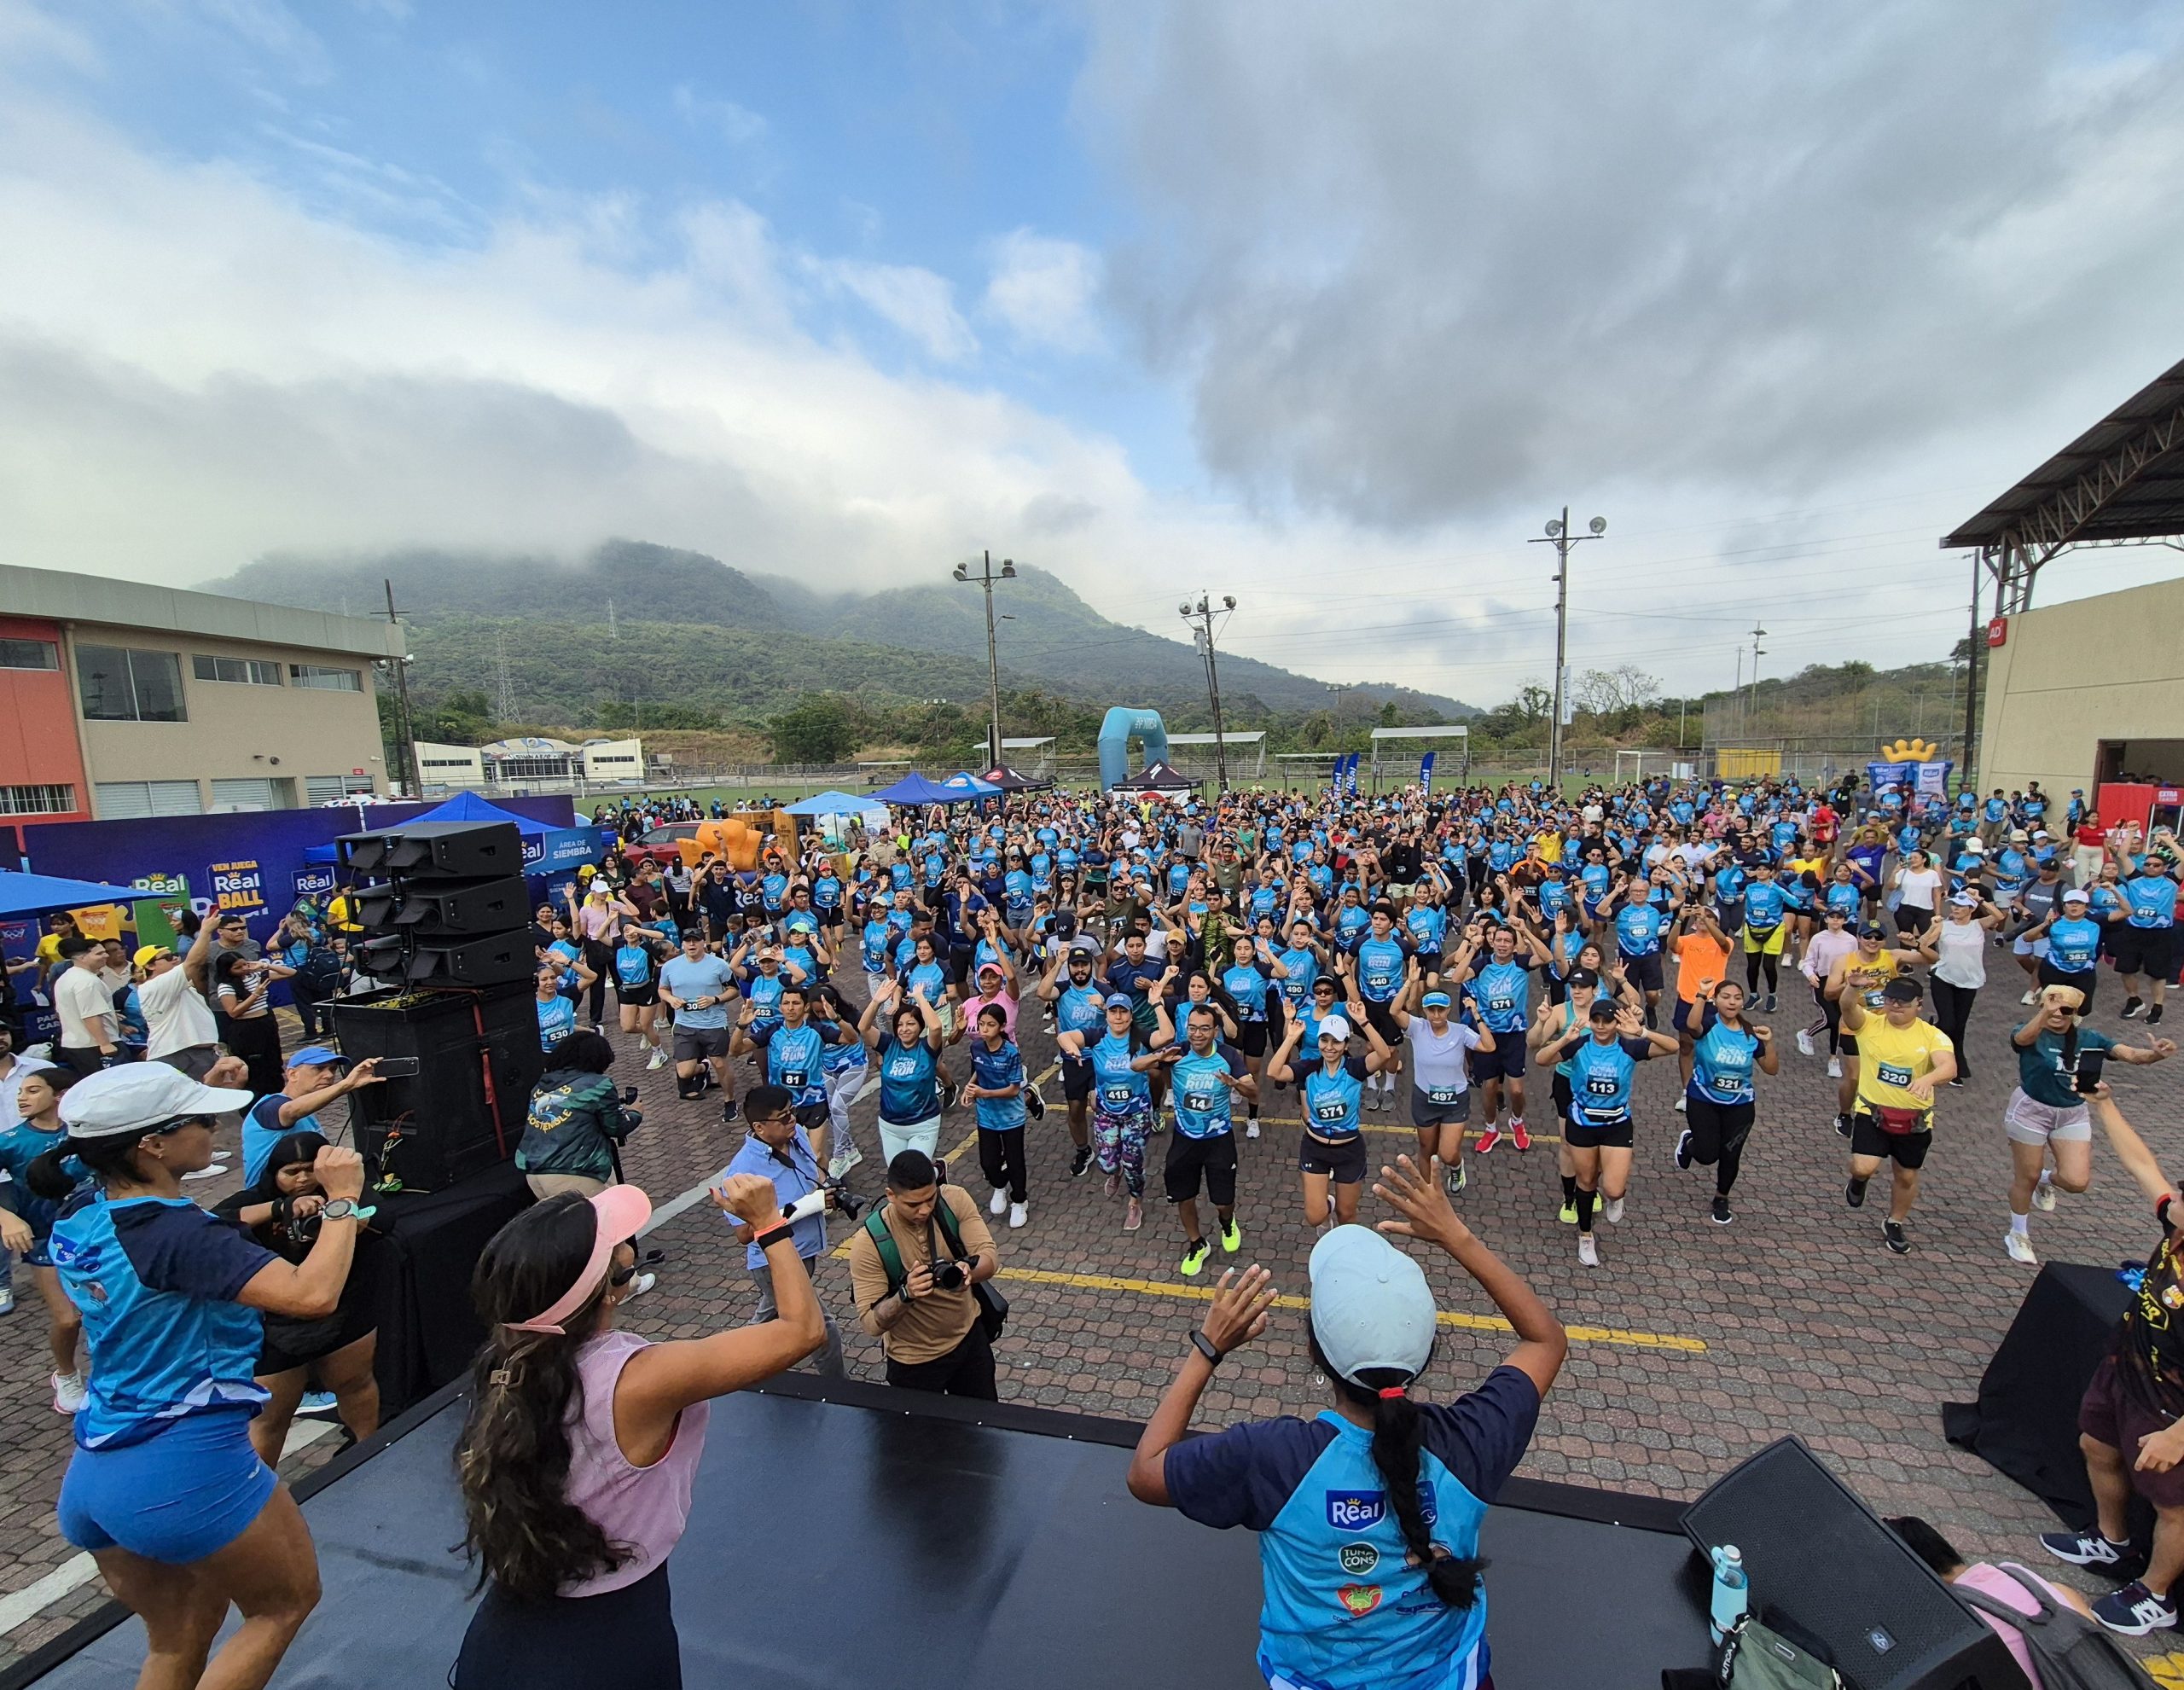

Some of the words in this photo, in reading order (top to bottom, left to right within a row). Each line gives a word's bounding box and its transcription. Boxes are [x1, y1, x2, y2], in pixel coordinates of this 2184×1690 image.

[1345, 767, 1356, 790] Real
[559, 839, 577, 849] ÁREA
[577, 839, 586, 847] DE
[522, 843, 541, 859] eal
[553, 845, 592, 859] SIEMBRA
[212, 862, 229, 872] VEN
[231, 860, 258, 870] JUEGA
[135, 874, 185, 892] Real
[214, 872, 261, 892] Real
[297, 874, 330, 891] Real
[218, 889, 264, 910] BALL
[1417, 931, 1430, 939] 402
[1492, 1000, 1511, 1008] 571
[549, 1030, 568, 1041] 530
[780, 1052, 806, 1062] RUN
[1716, 1054, 1747, 1066] RUN
[890, 1066, 915, 1076] RUN
[1881, 1070, 1908, 1084] 320
[786, 1075, 799, 1084] 81
[1186, 1080, 1214, 1090] RUN
[1716, 1078, 1740, 1089] 321
[1590, 1083, 1615, 1093] 113
[1108, 1090, 1130, 1100] 418
[1190, 1098, 1205, 1110] 14
[1320, 1105, 1344, 1118] 371
[1332, 1501, 1379, 1524] Real
[1345, 1556, 1374, 1567] CONS
